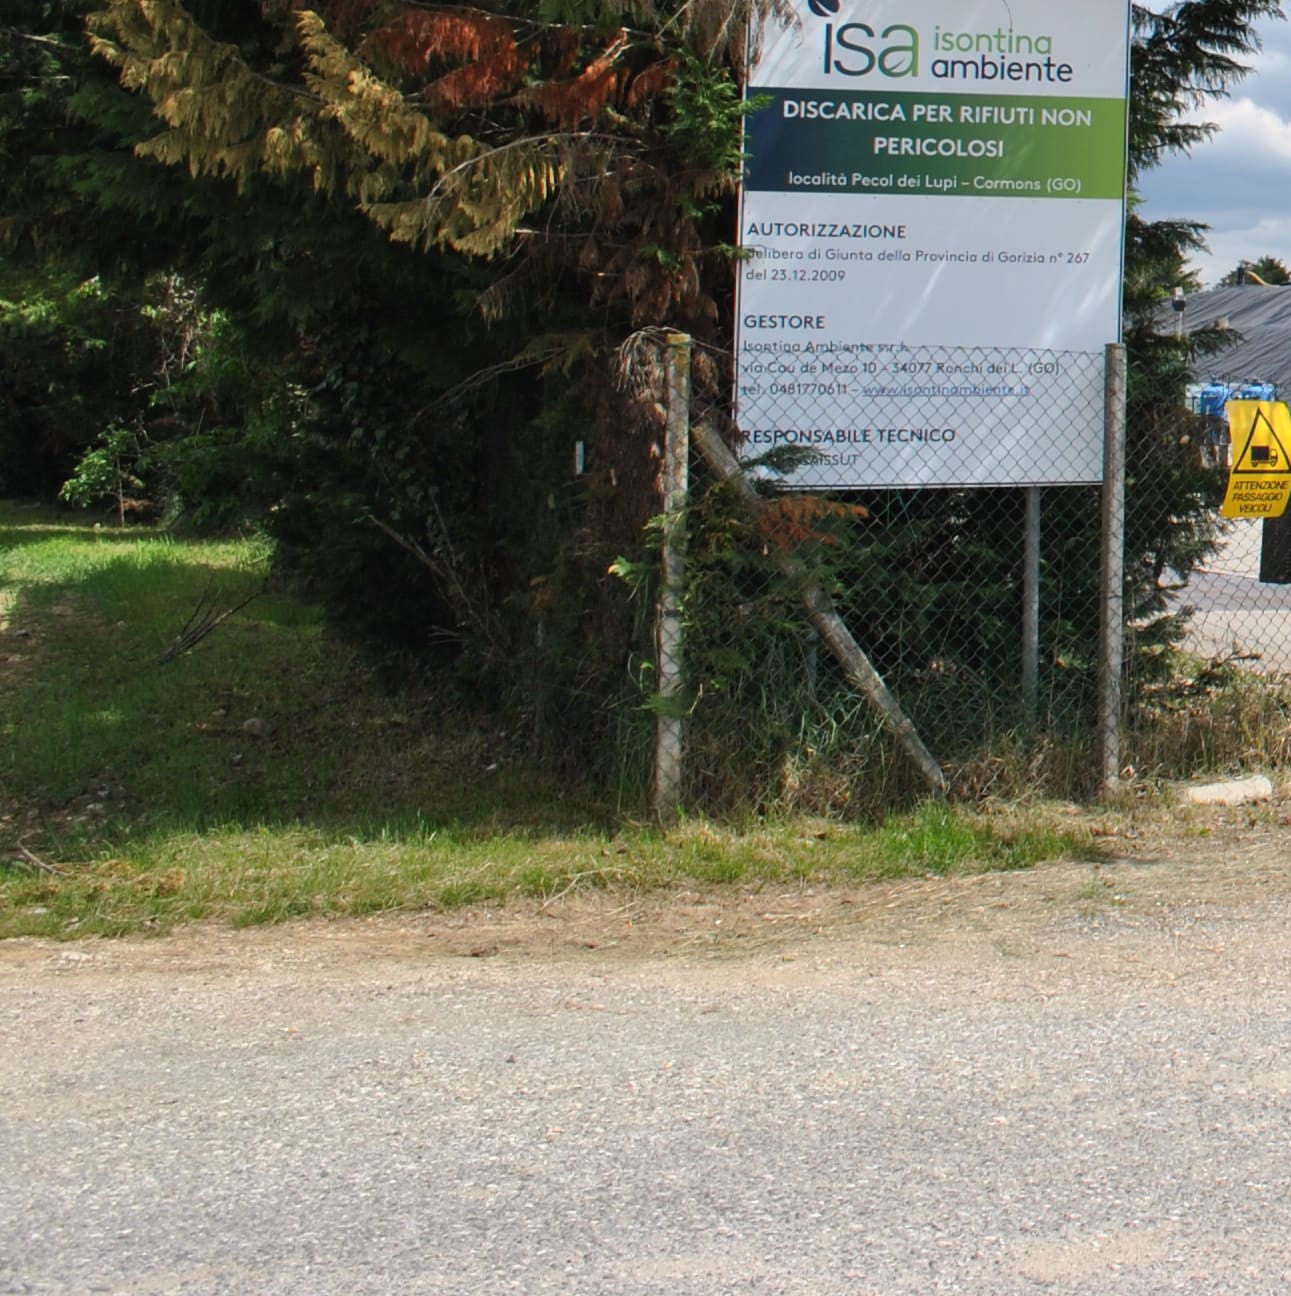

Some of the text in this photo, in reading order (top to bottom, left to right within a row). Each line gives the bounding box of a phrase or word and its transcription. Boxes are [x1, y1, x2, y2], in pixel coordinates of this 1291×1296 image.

[934, 26, 1052, 54] isontina
[931, 54, 1073, 82] ambiente
[783, 100, 1092, 126] DISCARICA PER RIFIUTI NON
[874, 137, 1004, 157] PERICOLOSI
[789, 171, 847, 186] località
[852, 173, 893, 188] Pecol
[898, 174, 921, 188] dei
[925, 174, 957, 191] Lupi
[974, 176, 1041, 191] Cormons
[1046, 178, 1082, 193] (GO)
[747, 223, 907, 238] AUTORIZZAZIONE
[809, 248, 821, 260] di
[825, 249, 873, 261] Giunta
[878, 249, 911, 262] della
[916, 250, 977, 263] Provincia
[982, 251, 994, 263] di
[998, 251, 1045, 264] Gorizia
[1067, 252, 1089, 264] 267
[746, 268, 845, 281] del 23.12.2009
[744, 315, 825, 329] GESTORE
[804, 341, 873, 353] Ambiente
[800, 362, 817, 374] de
[863, 362, 877, 373] 10
[892, 362, 932, 374] 34077
[936, 362, 983, 374] Ronchi
[743, 429, 956, 443] RESPONSABILE TECNICO
[1234, 480, 1289, 490] ATTENZIONE
[1232, 492, 1283, 502] PASSAGGIO
